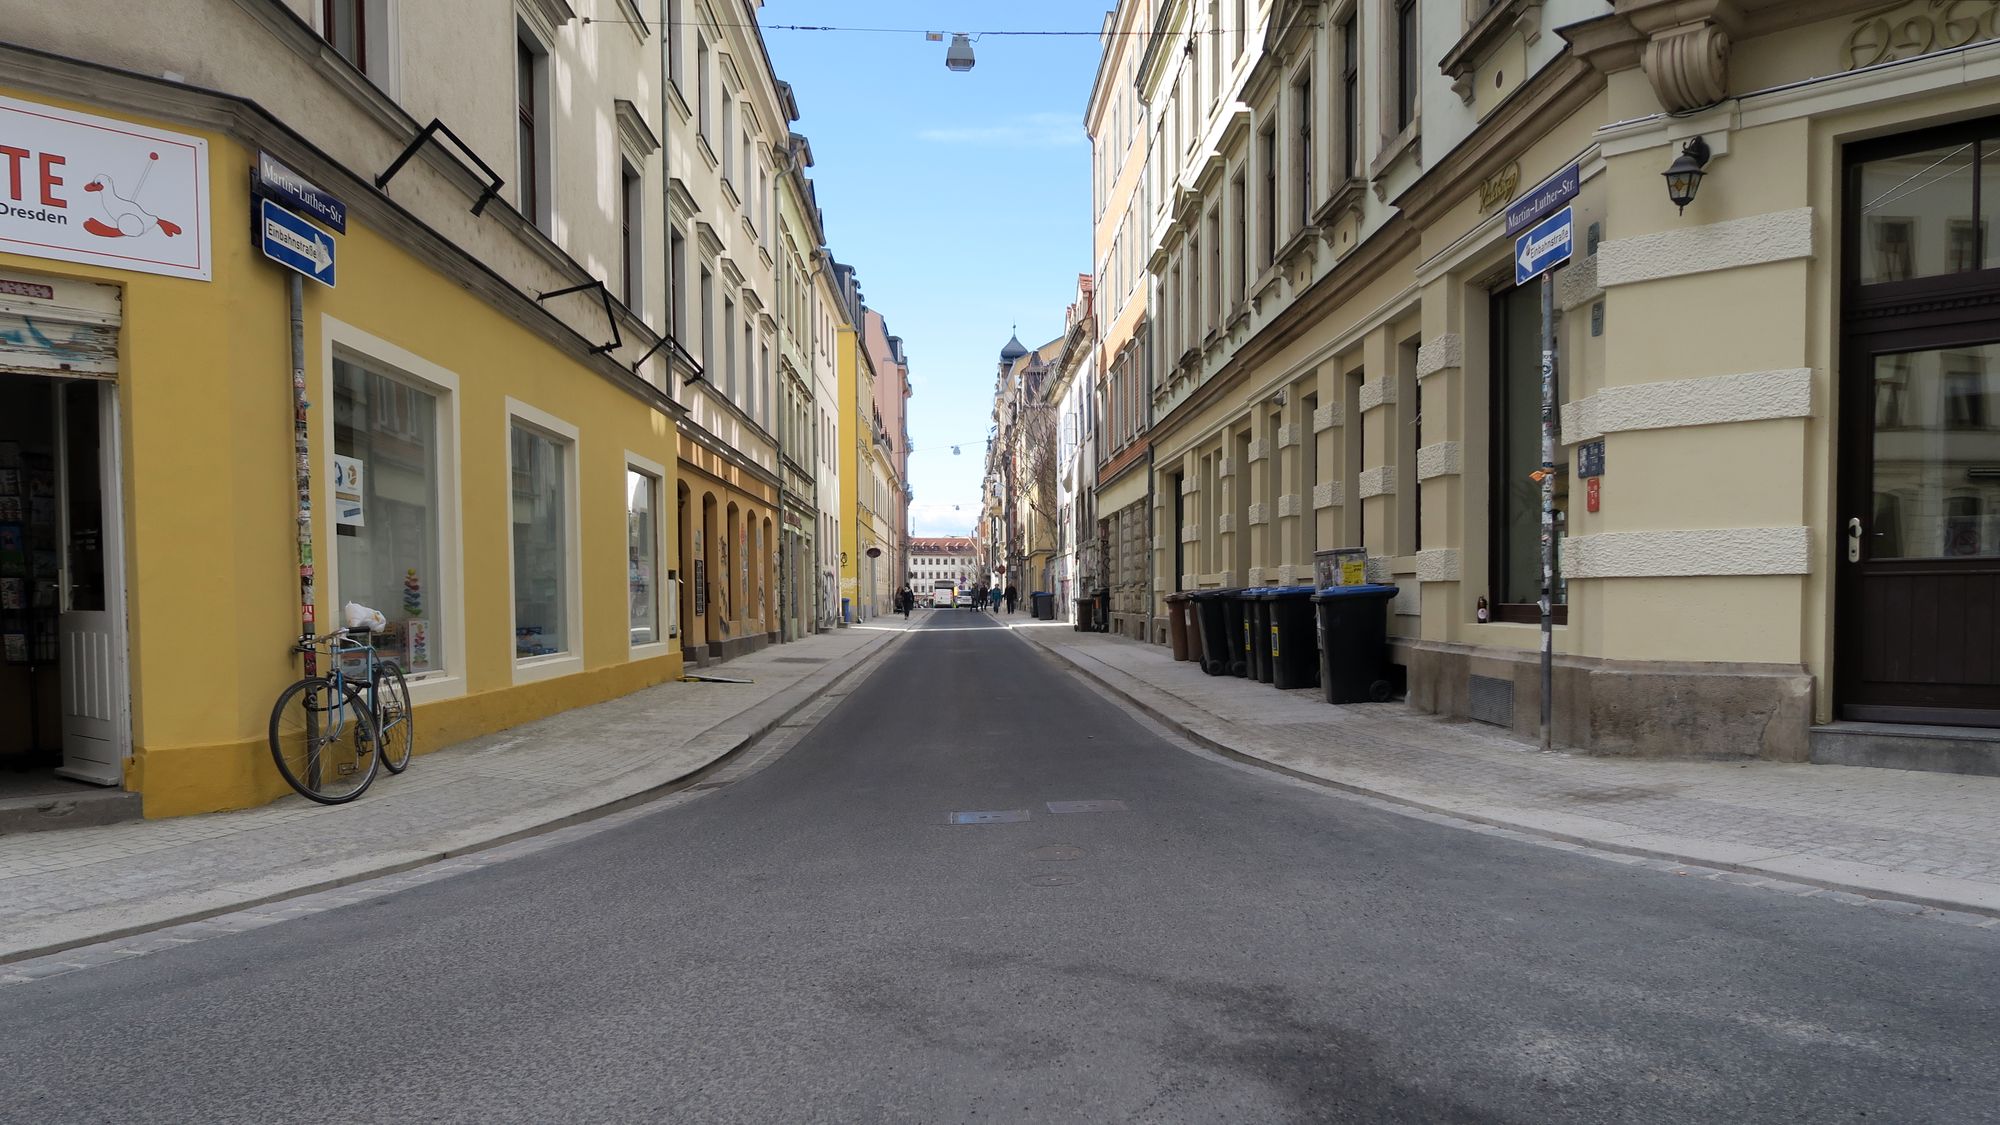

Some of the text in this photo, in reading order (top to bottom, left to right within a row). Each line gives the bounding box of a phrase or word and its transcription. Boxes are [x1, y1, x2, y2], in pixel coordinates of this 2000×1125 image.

[0, 145, 67, 208] TE
[264, 161, 343, 226] Martin-Luther-Str.
[0, 202, 67, 225] Dresden
[1508, 178, 1575, 229] Martin-Luther-Str.
[268, 223, 317, 259] Einbahnstraße
[1531, 228, 1569, 258] Einbahnstraße
